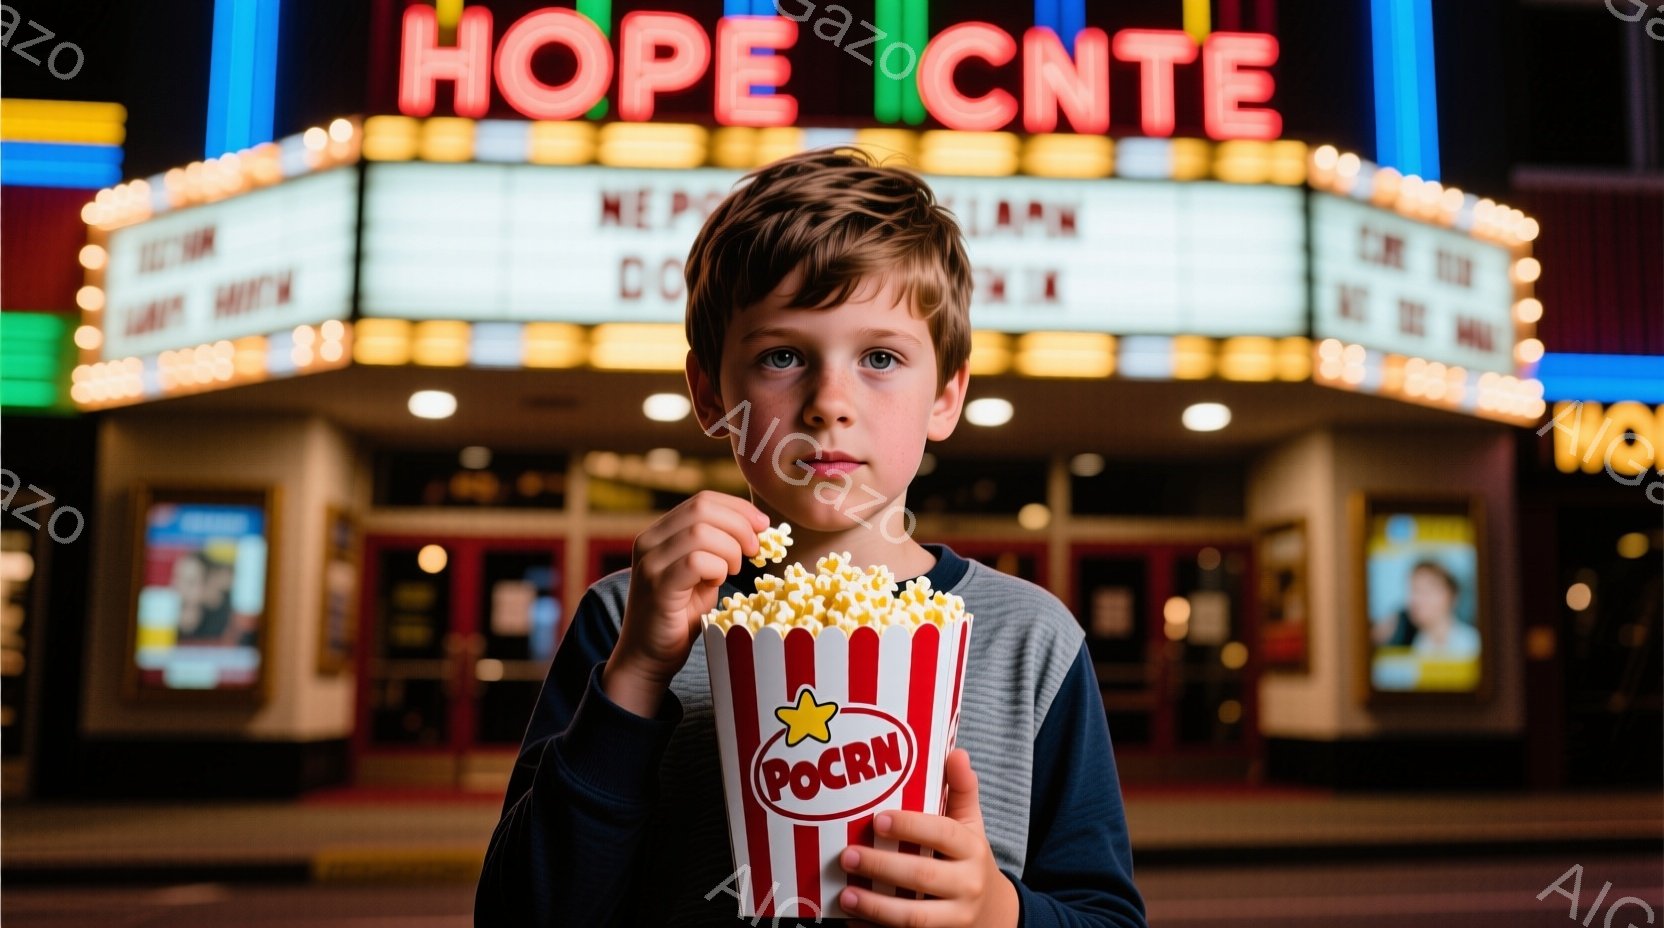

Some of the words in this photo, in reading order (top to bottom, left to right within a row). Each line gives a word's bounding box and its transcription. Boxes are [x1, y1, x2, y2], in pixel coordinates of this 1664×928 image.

[398, 4, 799, 127] HOPE
[916, 21, 1283, 141] CNTE
[761, 731, 903, 802] POCRN
